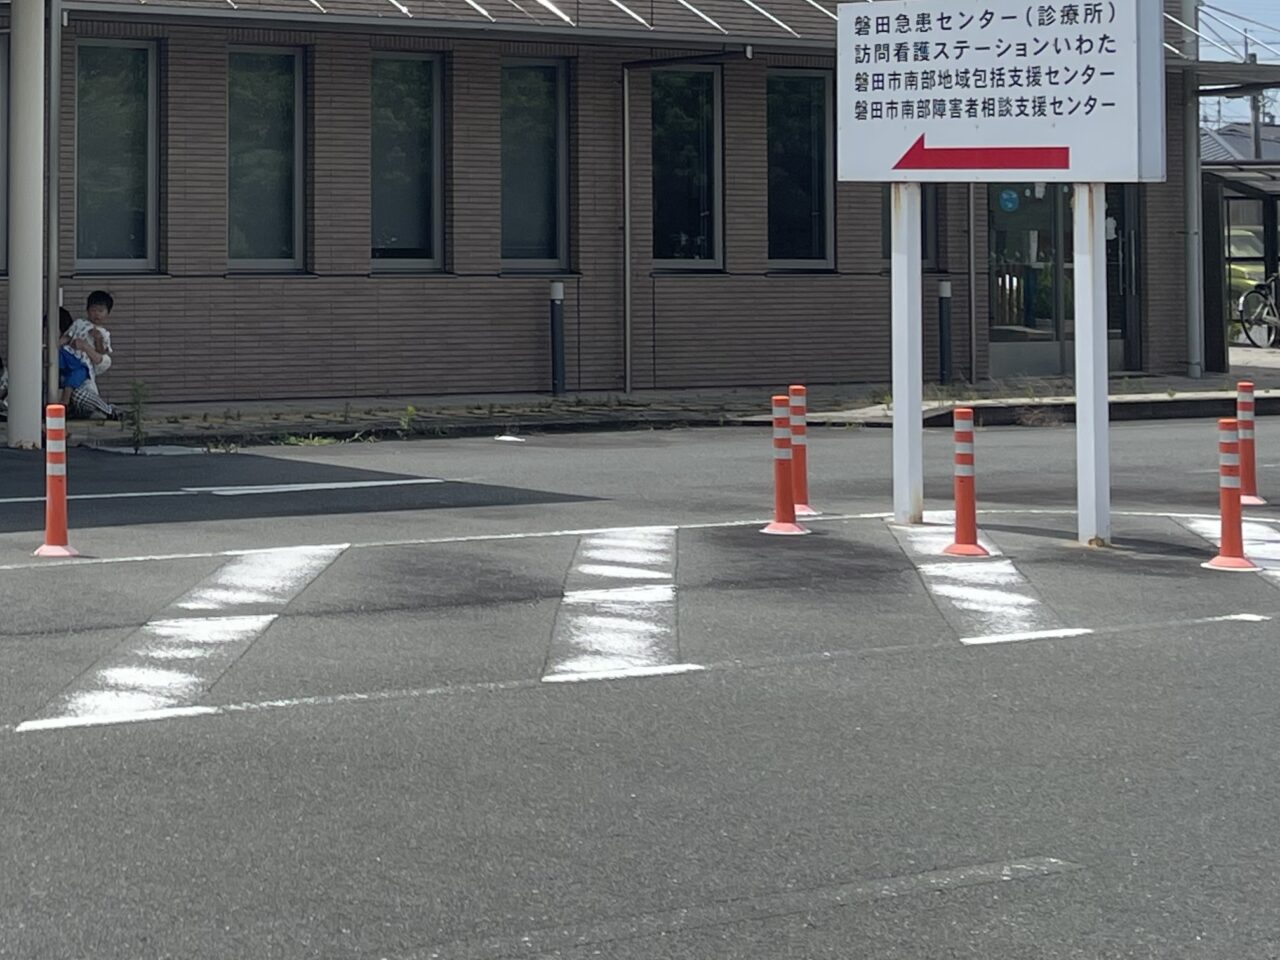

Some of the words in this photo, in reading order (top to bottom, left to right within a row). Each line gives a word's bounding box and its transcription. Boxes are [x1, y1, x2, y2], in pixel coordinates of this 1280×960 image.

[854, 1, 1116, 36] 磐田急患センター（診療所）
[854, 33, 1117, 64] 訪問看護ステーションいわた
[854, 64, 1116, 93] 磐田市南部地域包括支援センター
[854, 95, 1116, 121] 磐田市南部障害者相談支援センター
